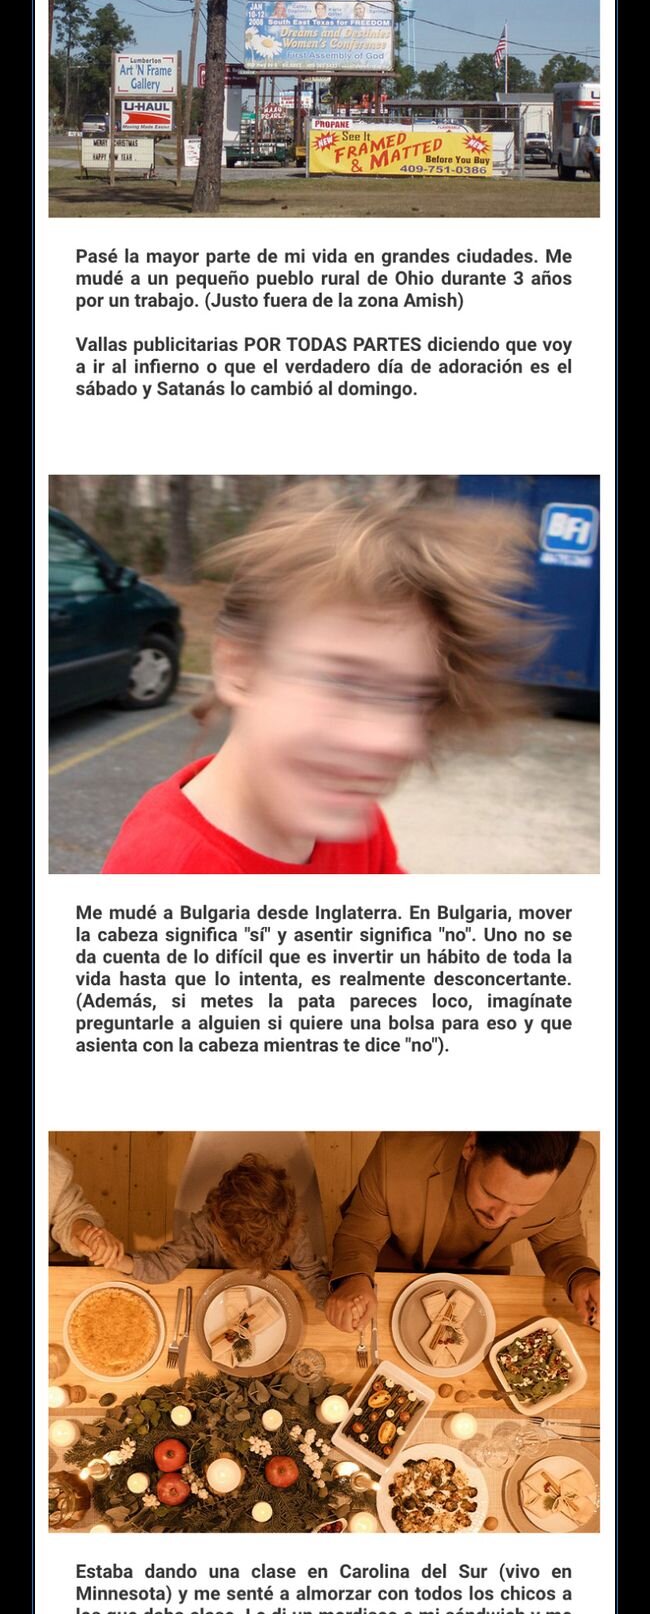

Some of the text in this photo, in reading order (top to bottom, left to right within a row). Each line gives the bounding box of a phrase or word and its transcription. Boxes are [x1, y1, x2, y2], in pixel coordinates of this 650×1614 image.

[250, 2, 263, 11] JAN
[280, 28, 318, 38] Dreams
[322, 28, 340, 38] and
[282, 38, 326, 49] Women's
[309, 51, 352, 60] Assembly
[354, 51, 363, 59] of
[120, 64, 172, 75] Art 'N Frame
[130, 78, 160, 92] Gallery
[124, 102, 170, 111] U-HAUL
[314, 120, 350, 129] PROPANE
[318, 135, 334, 148] NEW
[342, 131, 371, 142] See It
[93, 139, 138, 147] MERRY CHRISTMAS
[334, 133, 407, 164] FRAMED
[467, 138, 484, 151] NEW
[92, 153, 106, 161] HAPPY
[351, 138, 443, 172] & MATTED
[425, 155, 490, 166] Before You Buy
[400, 165, 487, 174] 409-751-0386
